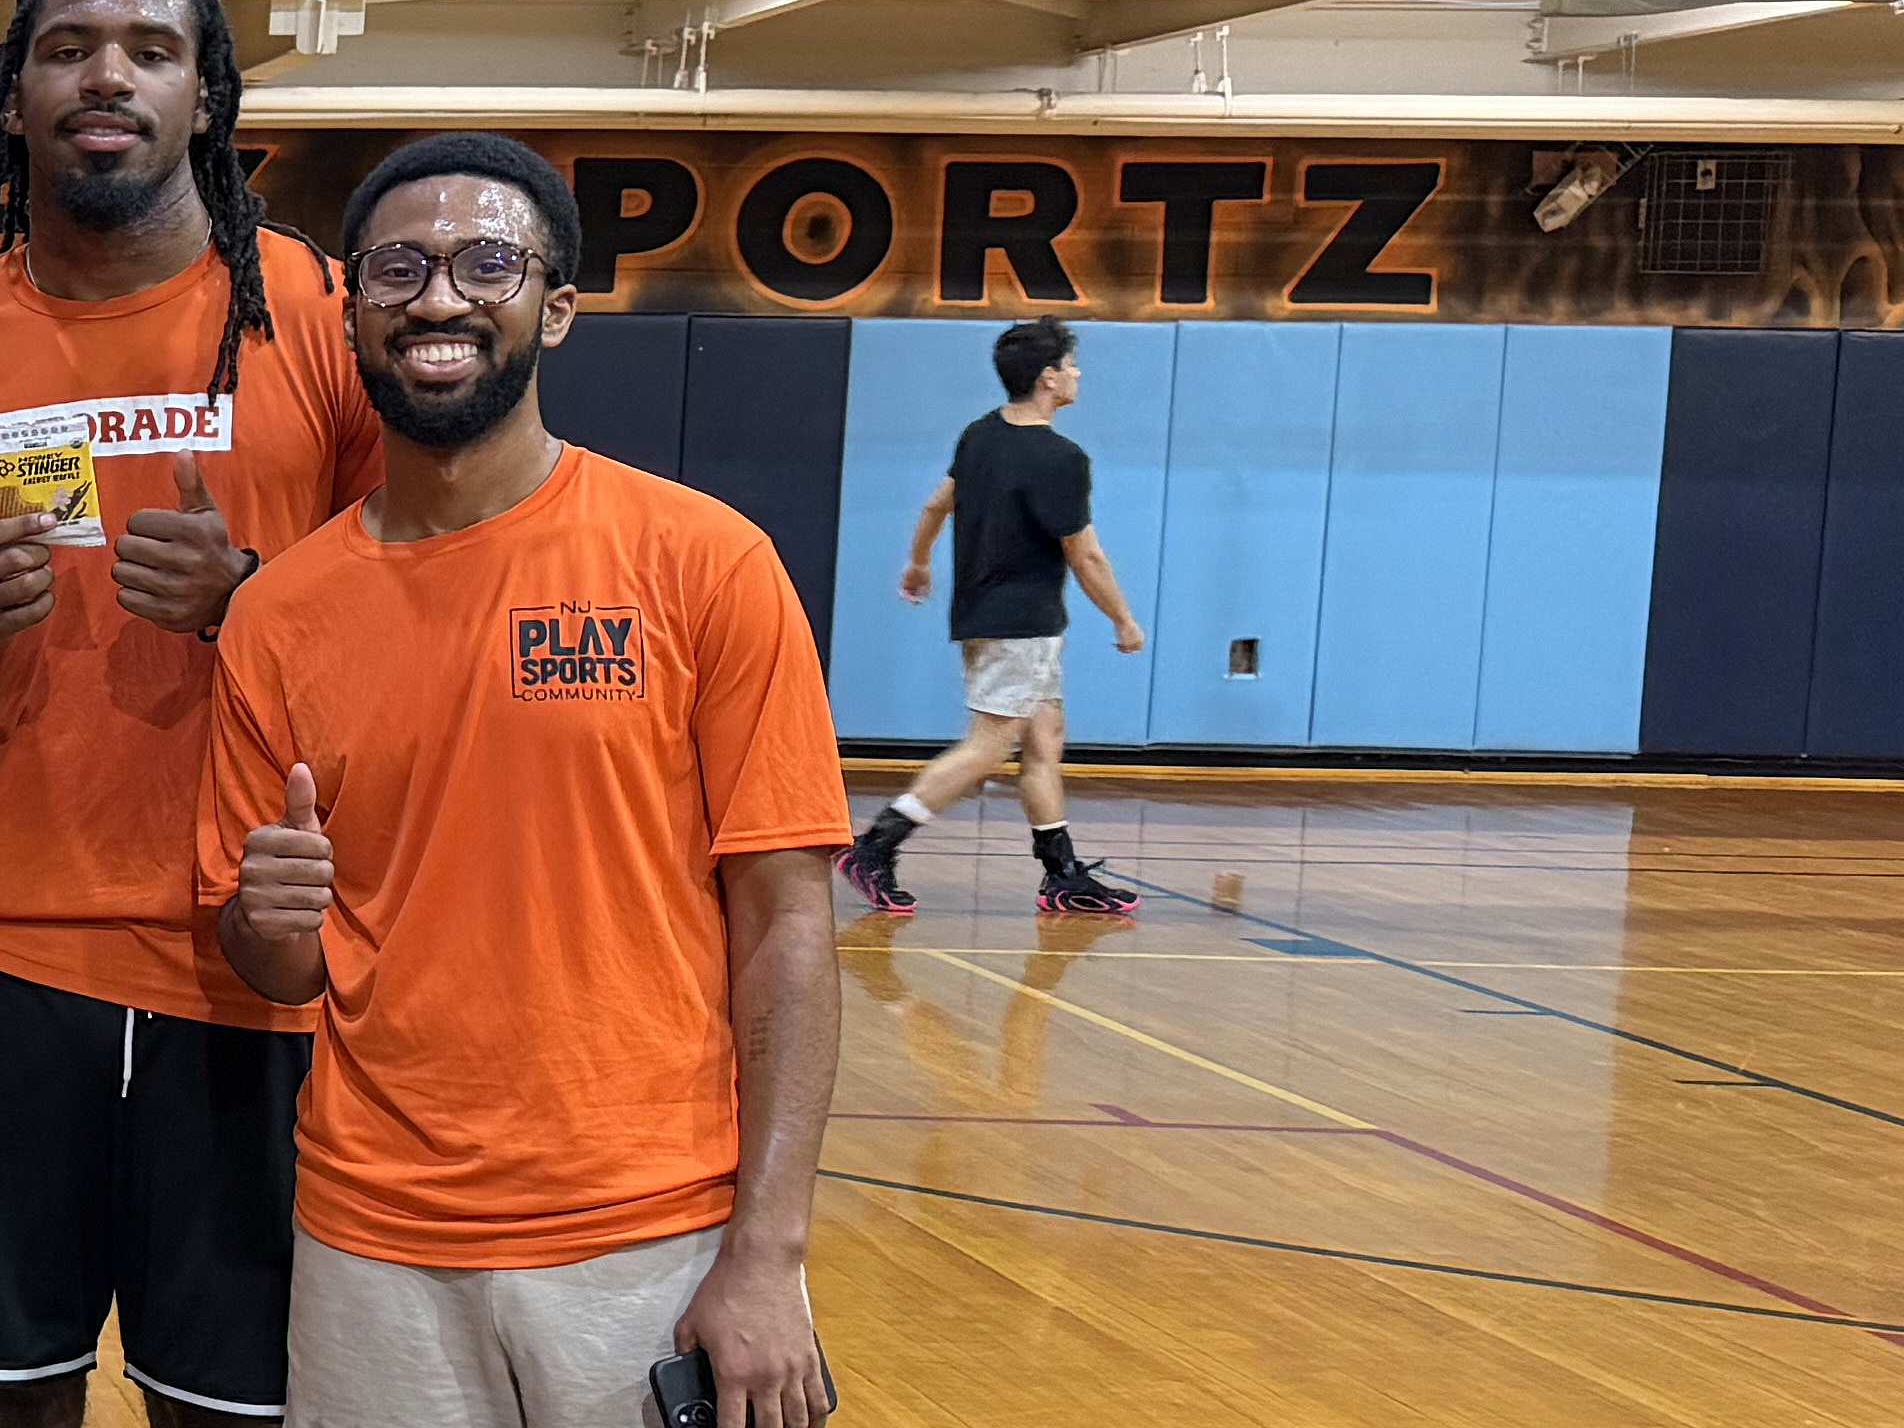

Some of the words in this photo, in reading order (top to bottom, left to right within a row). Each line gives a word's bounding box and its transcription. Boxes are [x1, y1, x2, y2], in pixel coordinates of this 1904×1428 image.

[572, 152, 1448, 308] PORTZ
[16, 457, 81, 478] STINGER
[560, 599, 592, 616] NJ
[518, 616, 633, 658] PLAY
[520, 656, 638, 687] SPORTS
[521, 687, 637, 702] COMMUNITY
